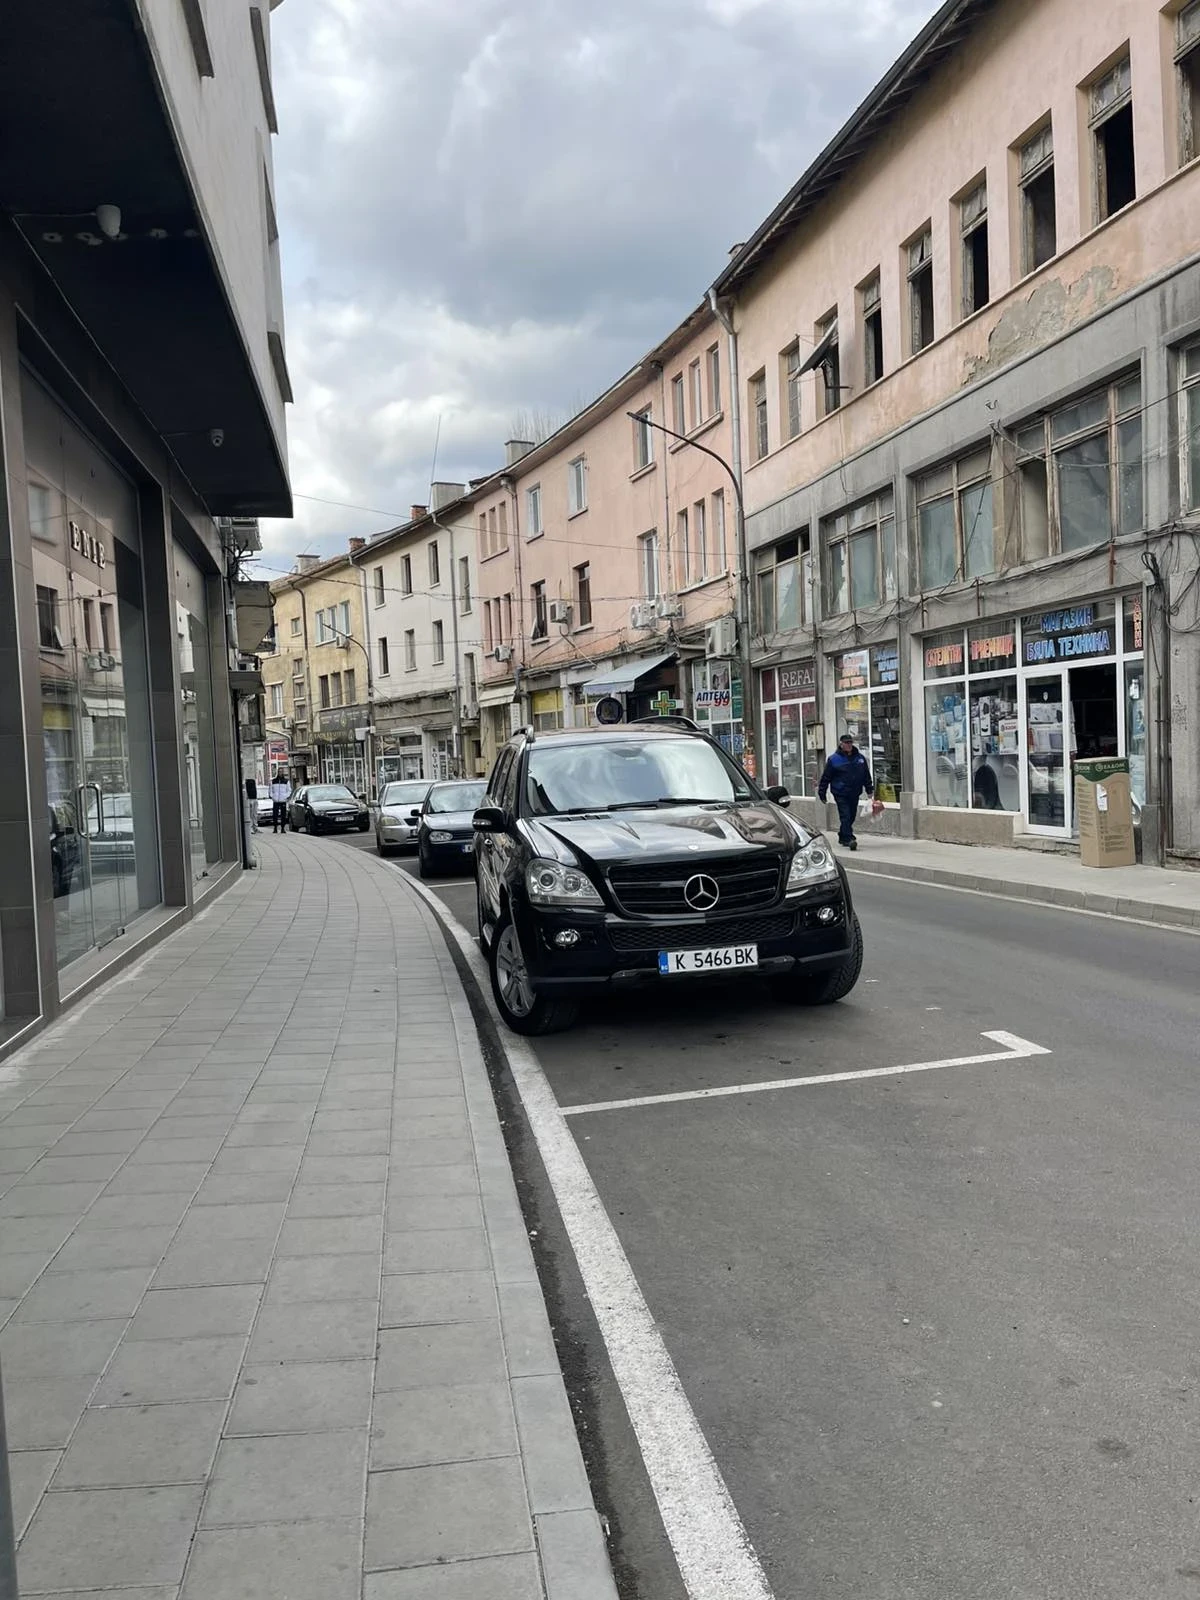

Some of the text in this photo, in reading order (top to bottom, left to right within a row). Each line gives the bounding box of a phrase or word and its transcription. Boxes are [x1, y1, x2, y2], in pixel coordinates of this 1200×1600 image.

[1041, 606, 1094, 634] МАГАЗИН
[1026, 629, 1111, 661] БЯЛА ТЕХНИКА
[696, 690, 730, 702] АПТЕКА
[714, 699, 729, 707] 99
[675, 947, 755, 970] K 5466 BK
